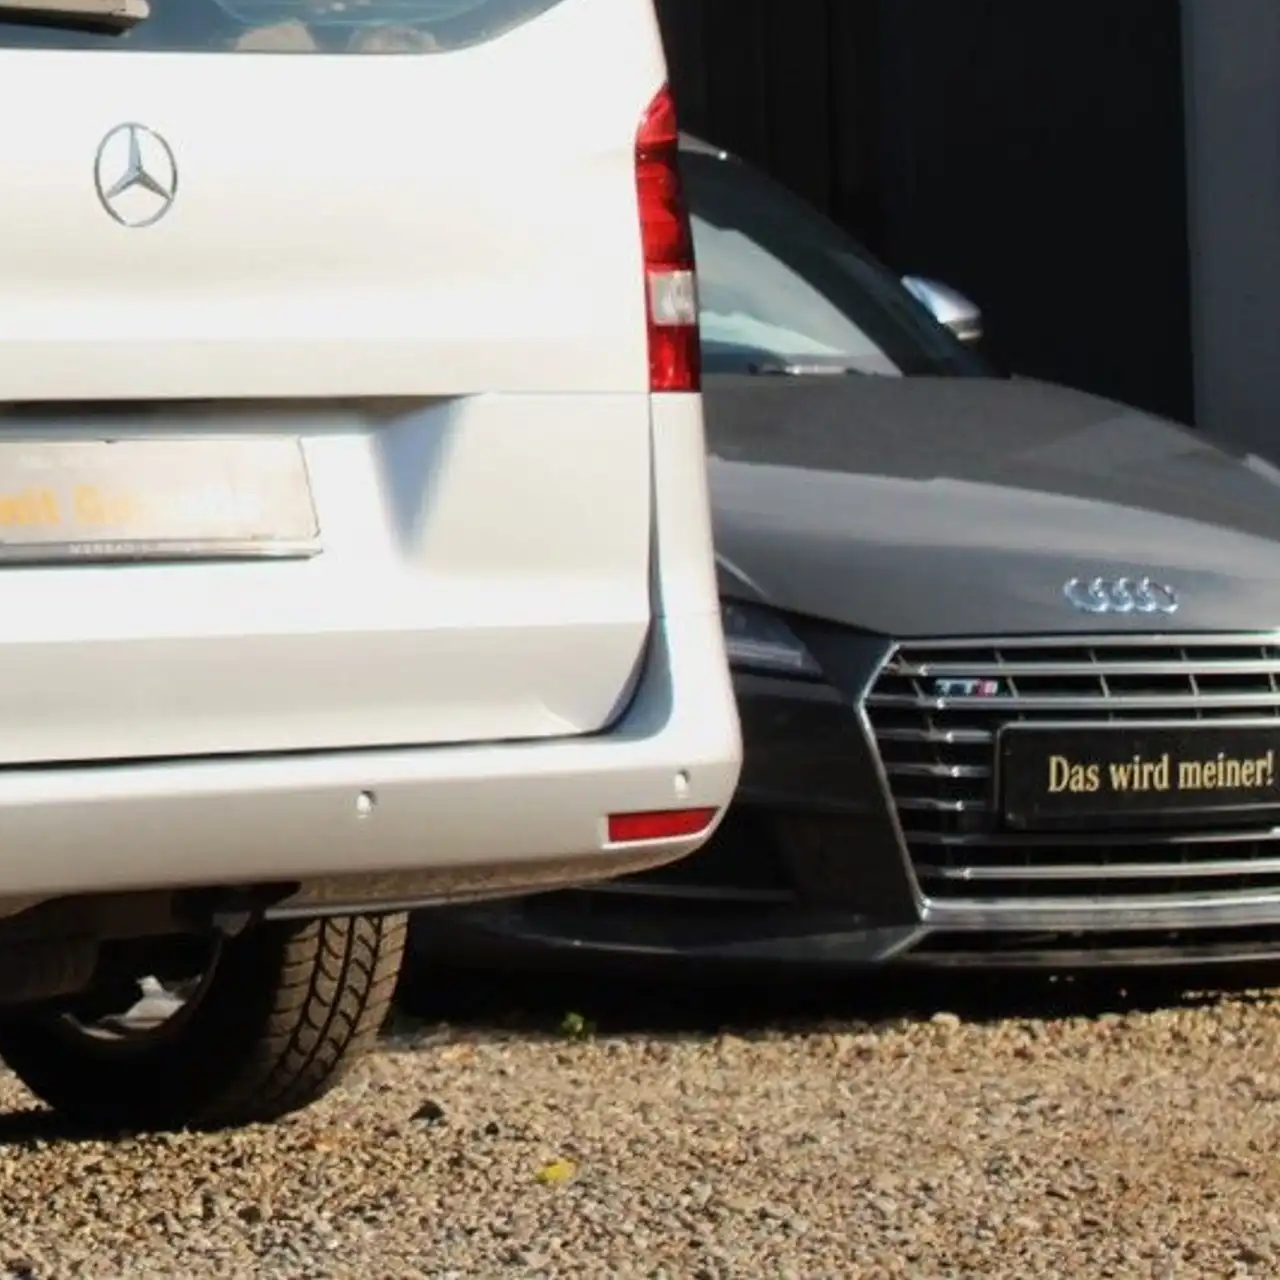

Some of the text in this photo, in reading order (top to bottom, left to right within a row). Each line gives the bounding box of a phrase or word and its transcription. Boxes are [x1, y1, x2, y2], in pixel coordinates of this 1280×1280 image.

[1048, 749, 1274, 792] Das wird meiner!
